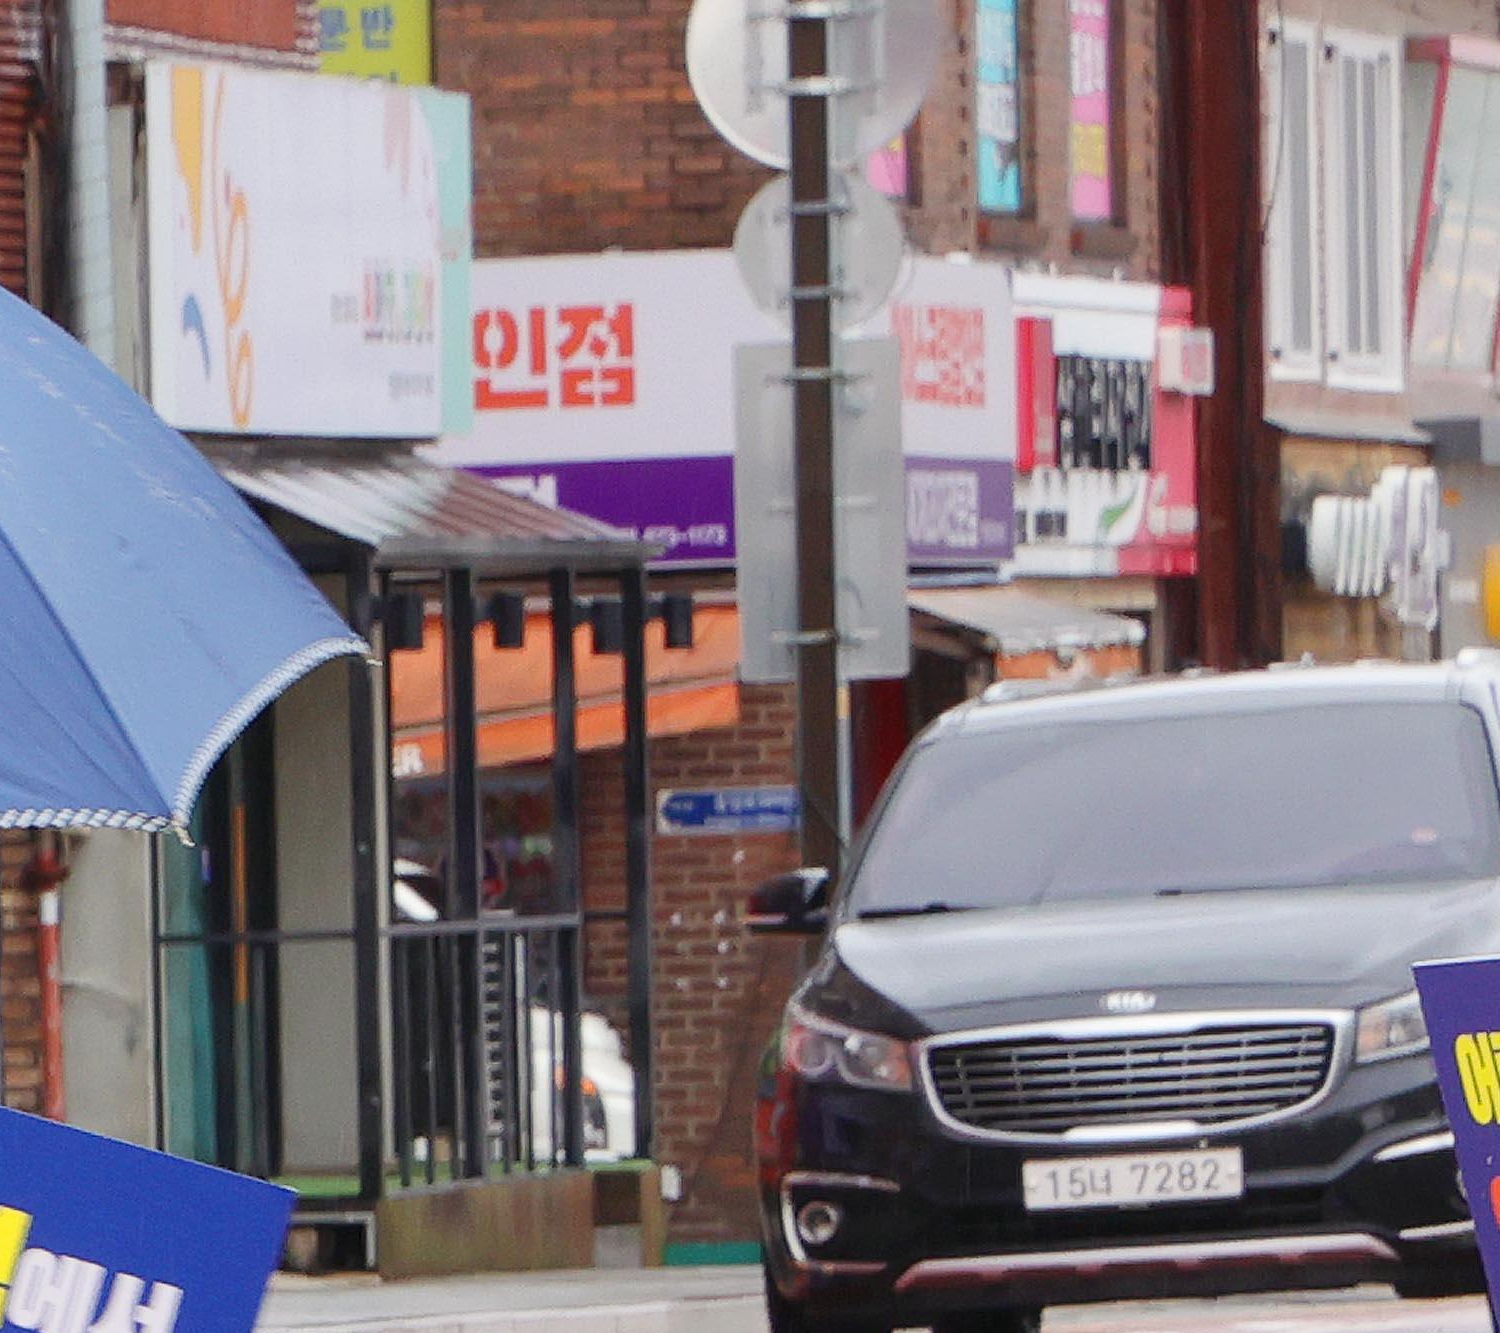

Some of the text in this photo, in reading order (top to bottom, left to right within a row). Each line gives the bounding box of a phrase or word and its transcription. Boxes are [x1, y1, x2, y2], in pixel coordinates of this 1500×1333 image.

[474, 303, 635, 411] 인점
[1454, 1031, 1500, 1126] 어
[1045, 1157, 1222, 1201] 15너 7282
